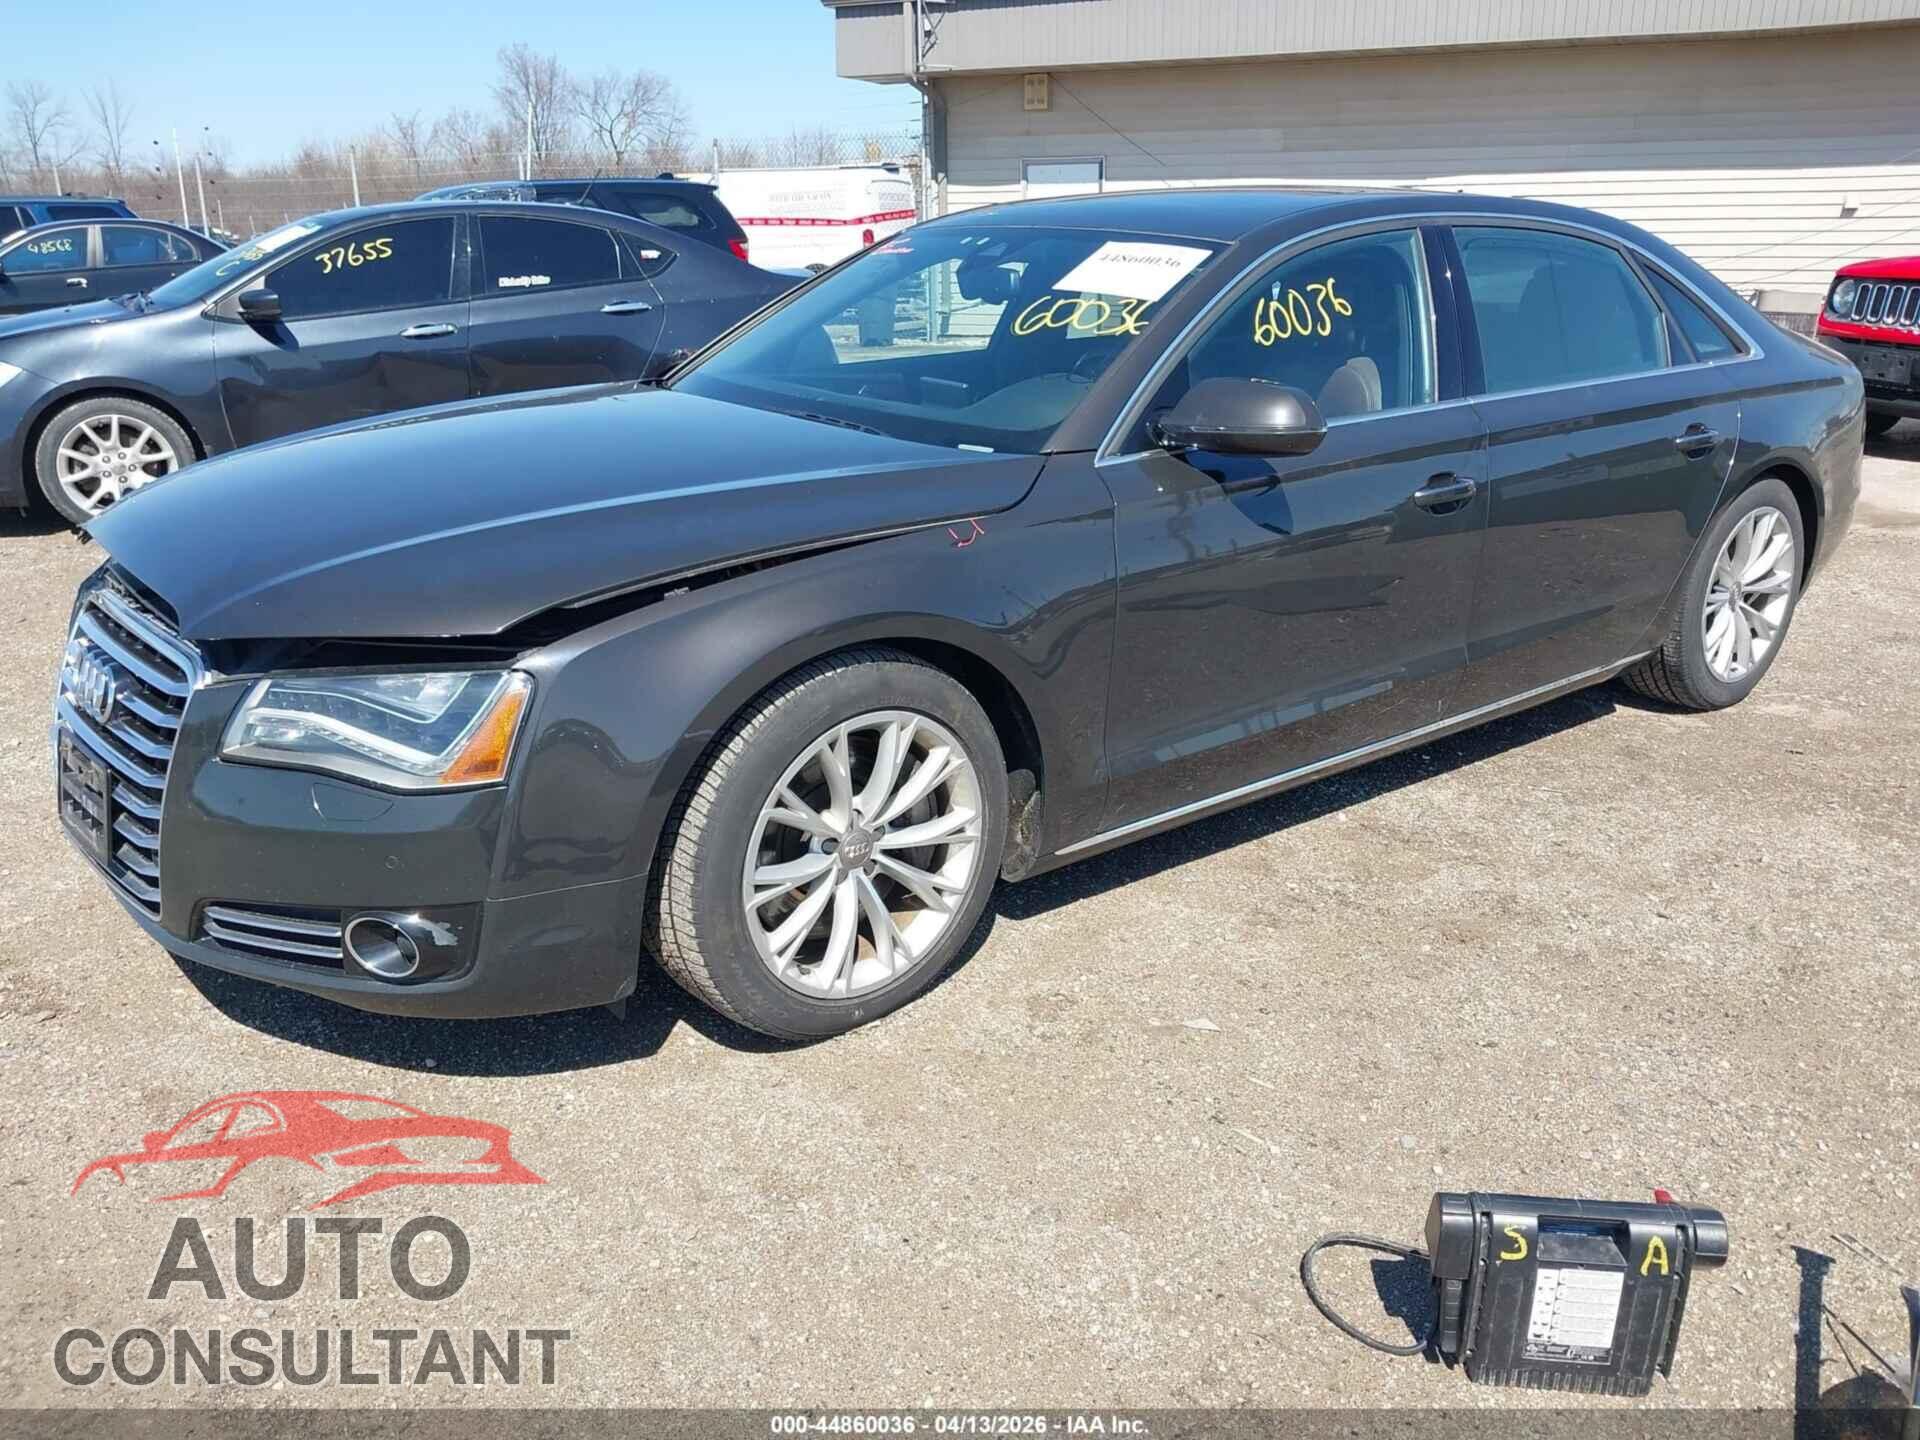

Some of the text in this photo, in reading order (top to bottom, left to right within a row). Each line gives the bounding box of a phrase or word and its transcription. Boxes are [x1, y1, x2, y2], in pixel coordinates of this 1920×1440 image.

[315, 238, 393, 273] 37655
[1254, 278, 1353, 346] 60036
[1500, 1225, 1528, 1261] S
[1640, 1235, 1669, 1276] A
